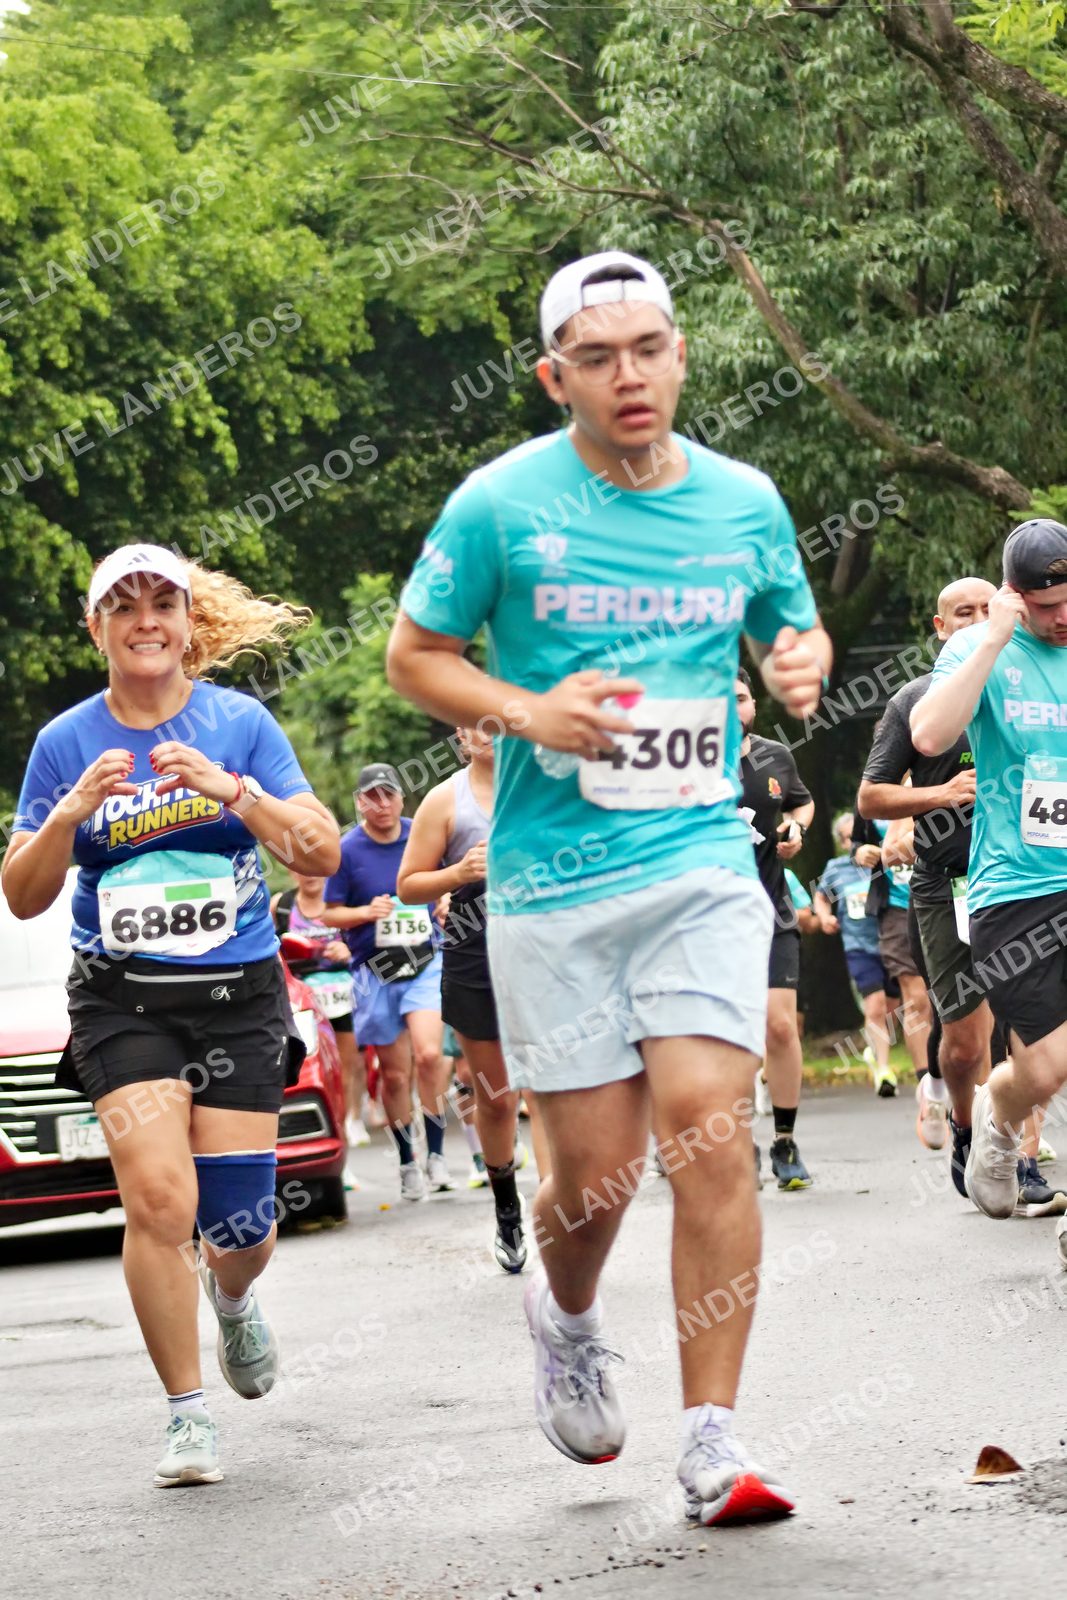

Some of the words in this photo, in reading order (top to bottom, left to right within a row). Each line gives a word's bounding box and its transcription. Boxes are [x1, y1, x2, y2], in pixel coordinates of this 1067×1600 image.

[534, 583, 745, 624] PERDURA
[1004, 699, 1067, 726] PER
[598, 727, 720, 770] 4306
[110, 796, 221, 848] RUNNERS
[112, 900, 227, 944] 6886
[381, 920, 428, 936] 3136
